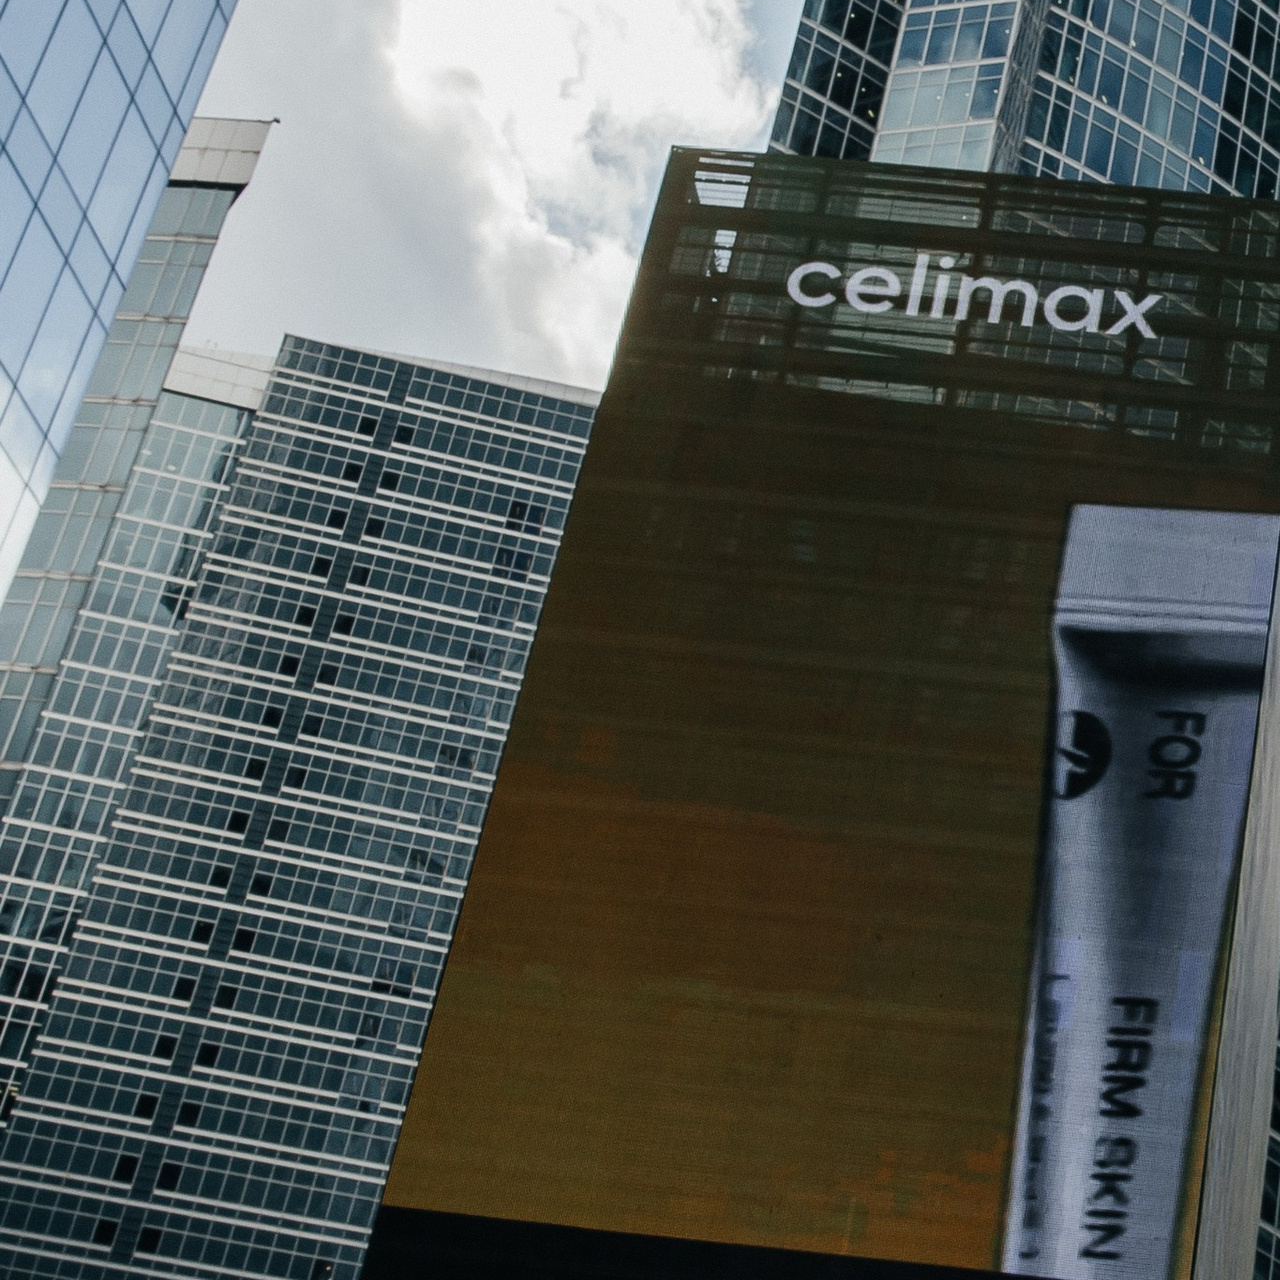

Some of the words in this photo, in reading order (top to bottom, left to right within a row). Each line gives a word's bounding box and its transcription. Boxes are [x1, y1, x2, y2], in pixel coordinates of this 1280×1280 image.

[786, 252, 1163, 339] celimax
[1145, 709, 1206, 801] FOR
[1097, 995, 1159, 1119] FIRM
